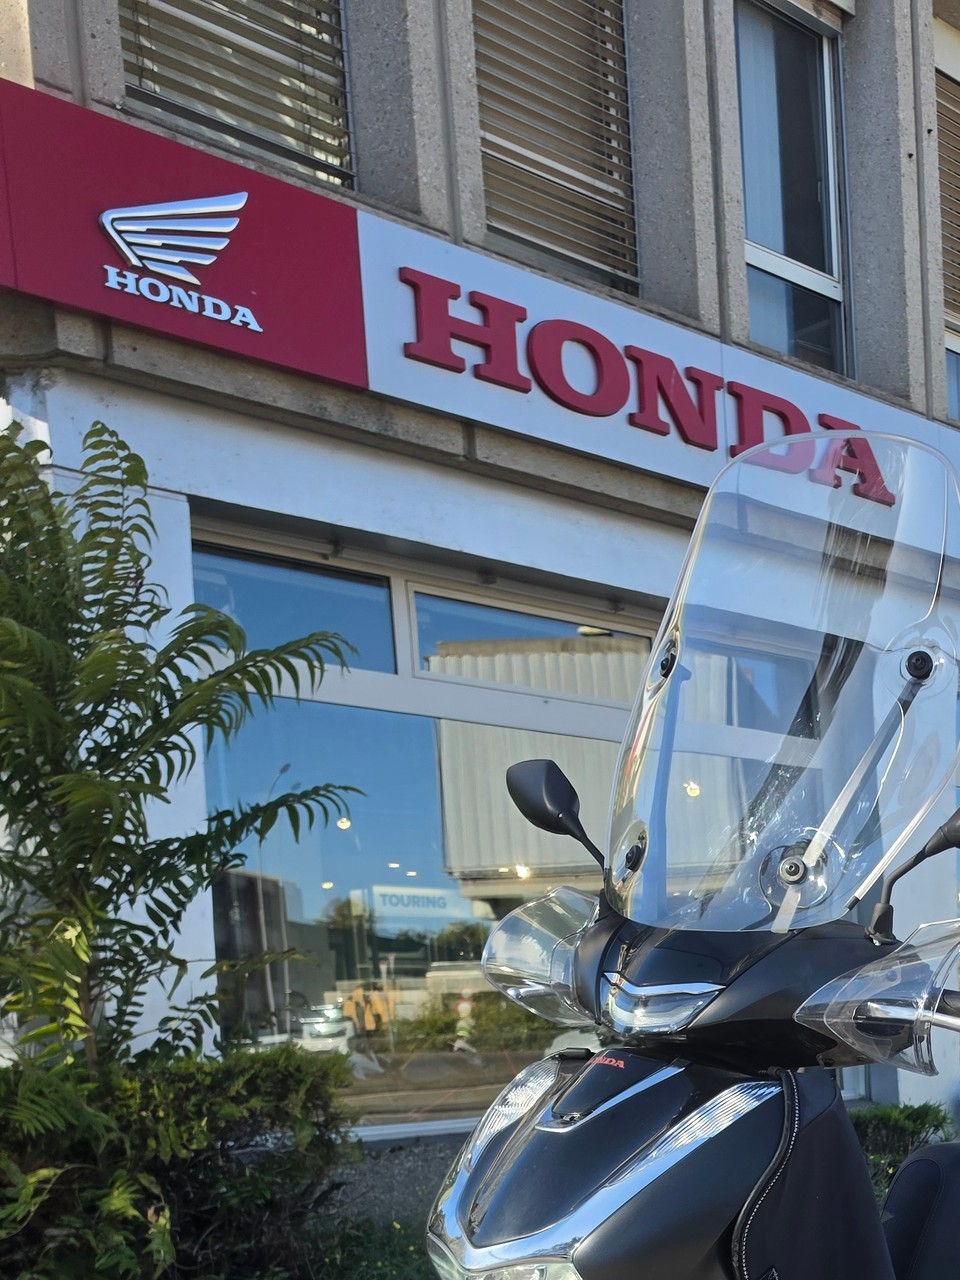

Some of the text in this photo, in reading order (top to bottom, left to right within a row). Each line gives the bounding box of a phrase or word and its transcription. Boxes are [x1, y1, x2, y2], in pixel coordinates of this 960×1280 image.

[103, 264, 264, 333] HONDA
[399, 266, 896, 507] HONDA
[379, 893, 447, 909] TOURING
